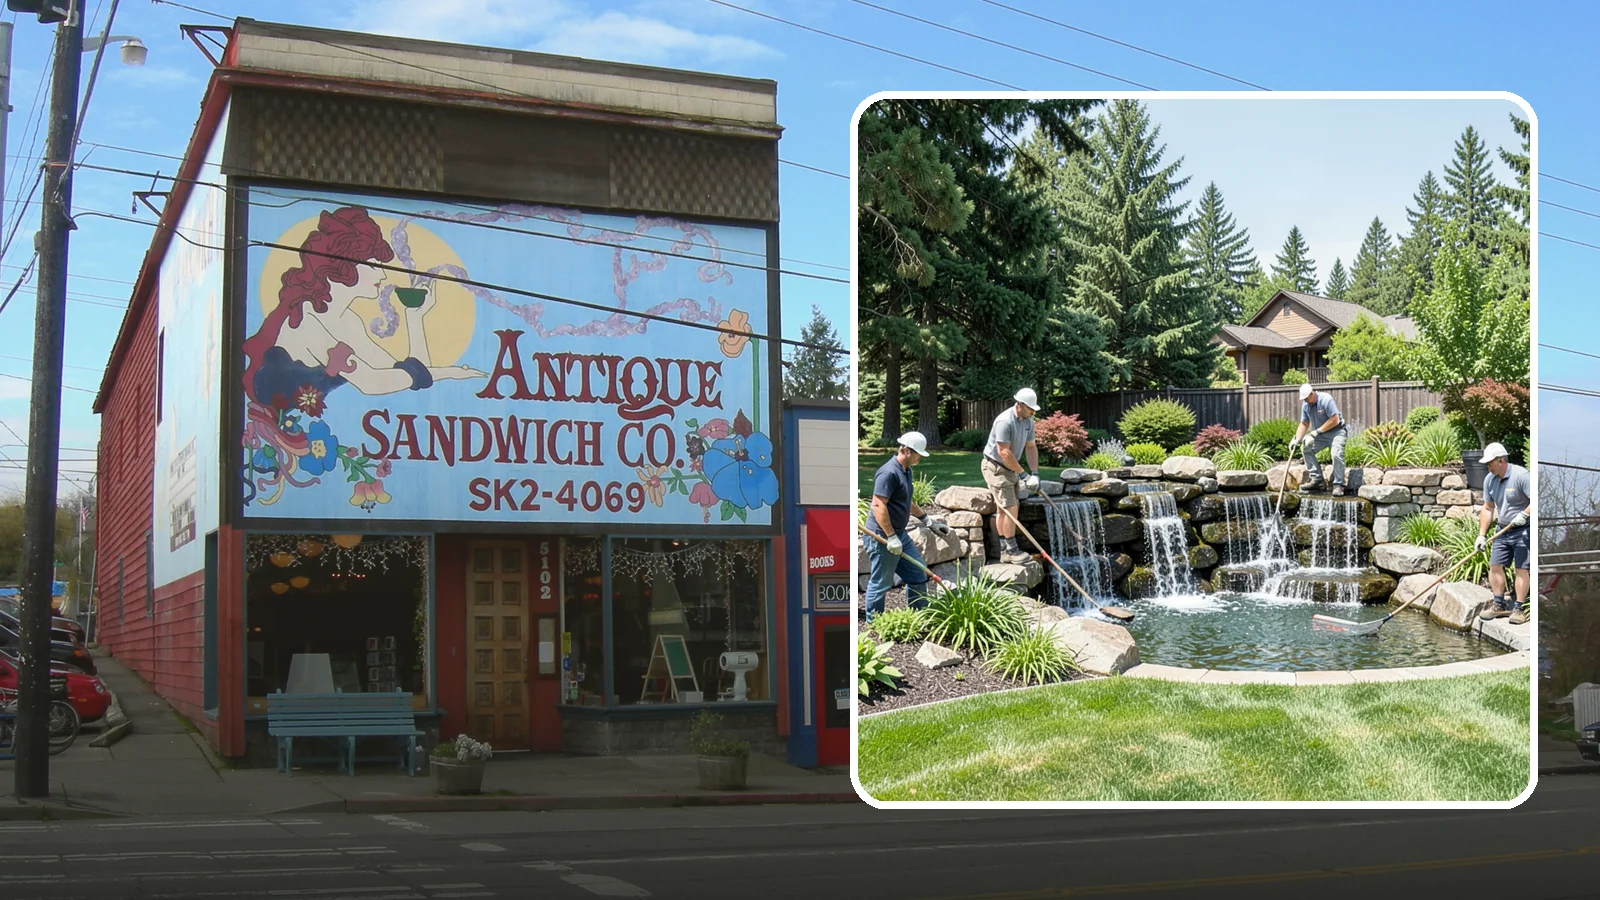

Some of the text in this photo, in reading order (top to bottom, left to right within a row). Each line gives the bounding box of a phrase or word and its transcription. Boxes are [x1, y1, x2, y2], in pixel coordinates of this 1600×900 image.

[476, 329, 722, 420] ANTIQUE
[361, 408, 684, 469] SANDWICH CO.
[468, 477, 645, 512] SK2-4069
[540, 541, 551, 599] 5102
[809, 555, 835, 569] BOOKS
